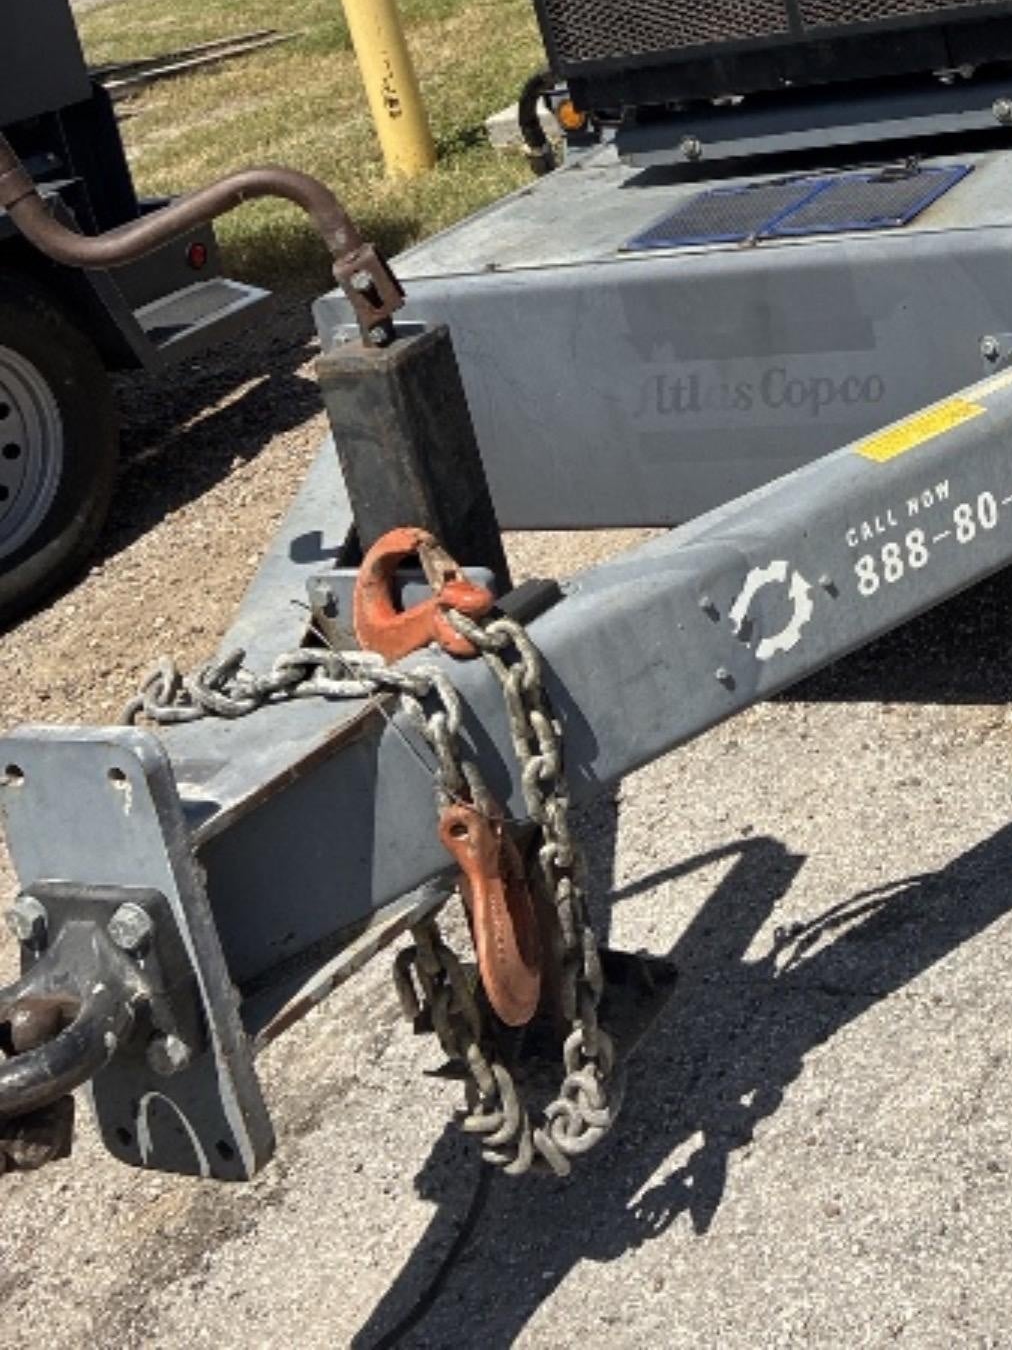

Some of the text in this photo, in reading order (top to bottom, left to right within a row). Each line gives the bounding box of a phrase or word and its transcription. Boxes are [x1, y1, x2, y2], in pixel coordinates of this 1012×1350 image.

[632, 367, 885, 418] Atls Copco
[845, 479, 950, 547] CALL NOW
